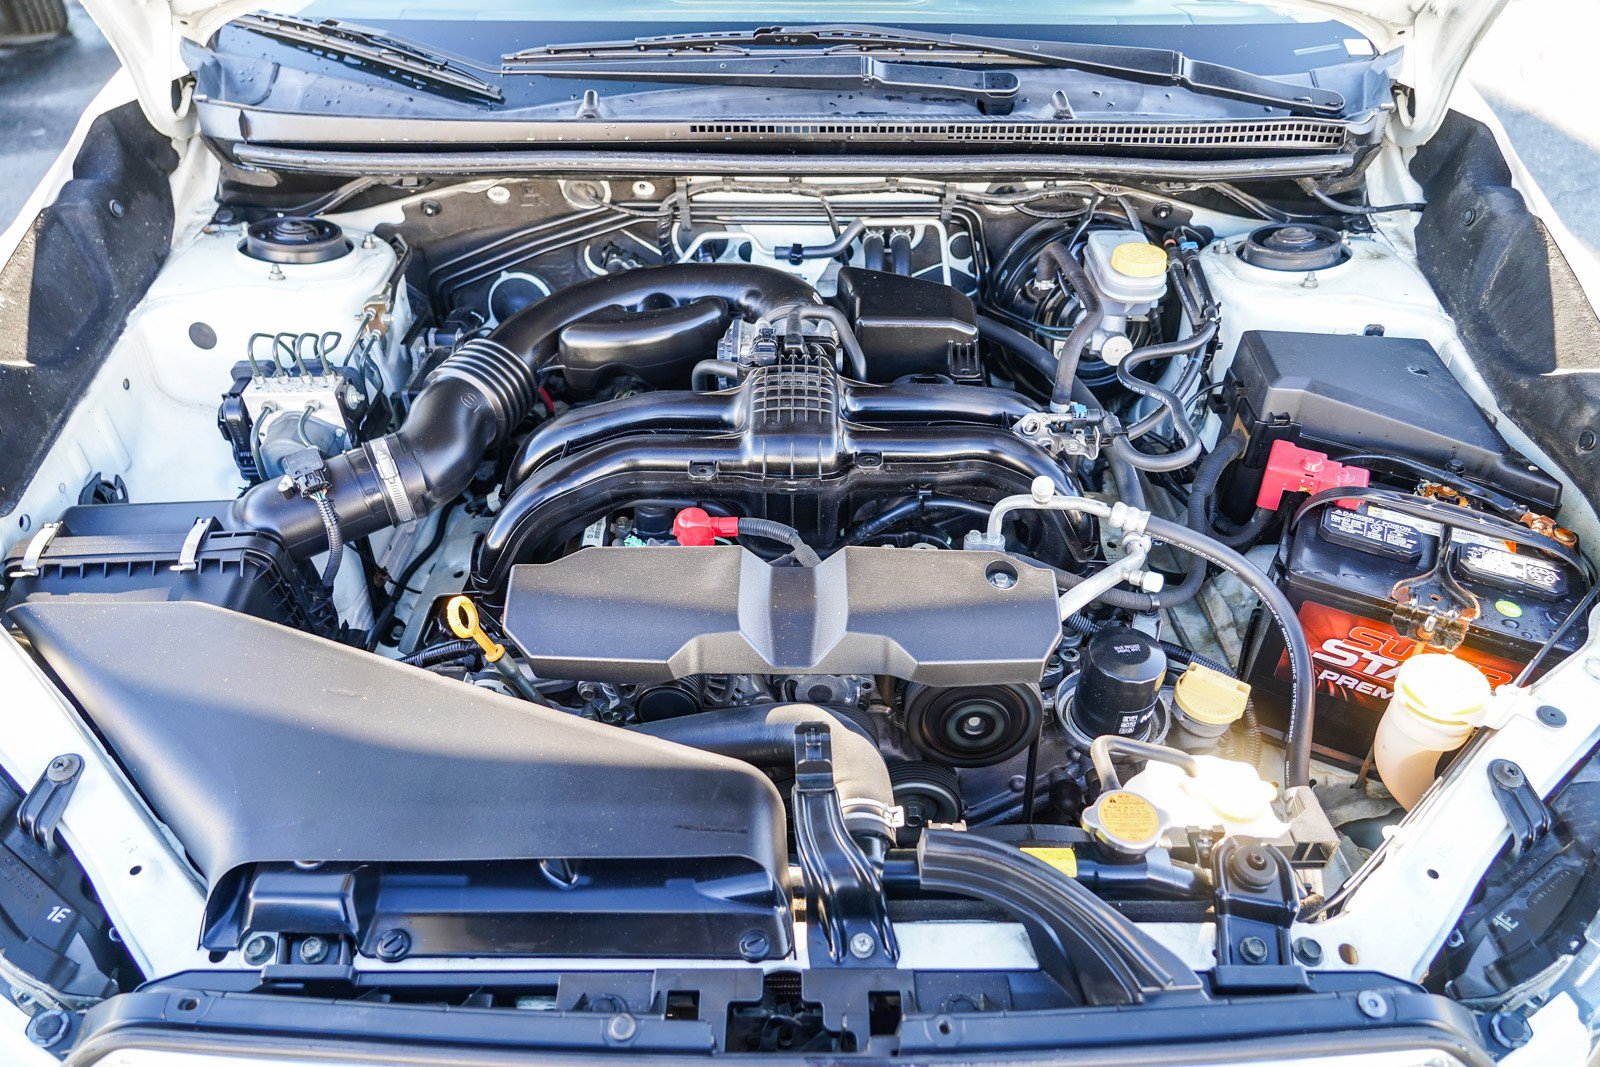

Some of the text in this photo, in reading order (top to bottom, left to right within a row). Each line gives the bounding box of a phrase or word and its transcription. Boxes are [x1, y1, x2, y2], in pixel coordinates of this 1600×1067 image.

[1341, 511, 1374, 524] DANGER
[1380, 520, 1412, 532] POISON
[47, 905, 72, 923] 1E
[1492, 911, 1519, 932] 1E
